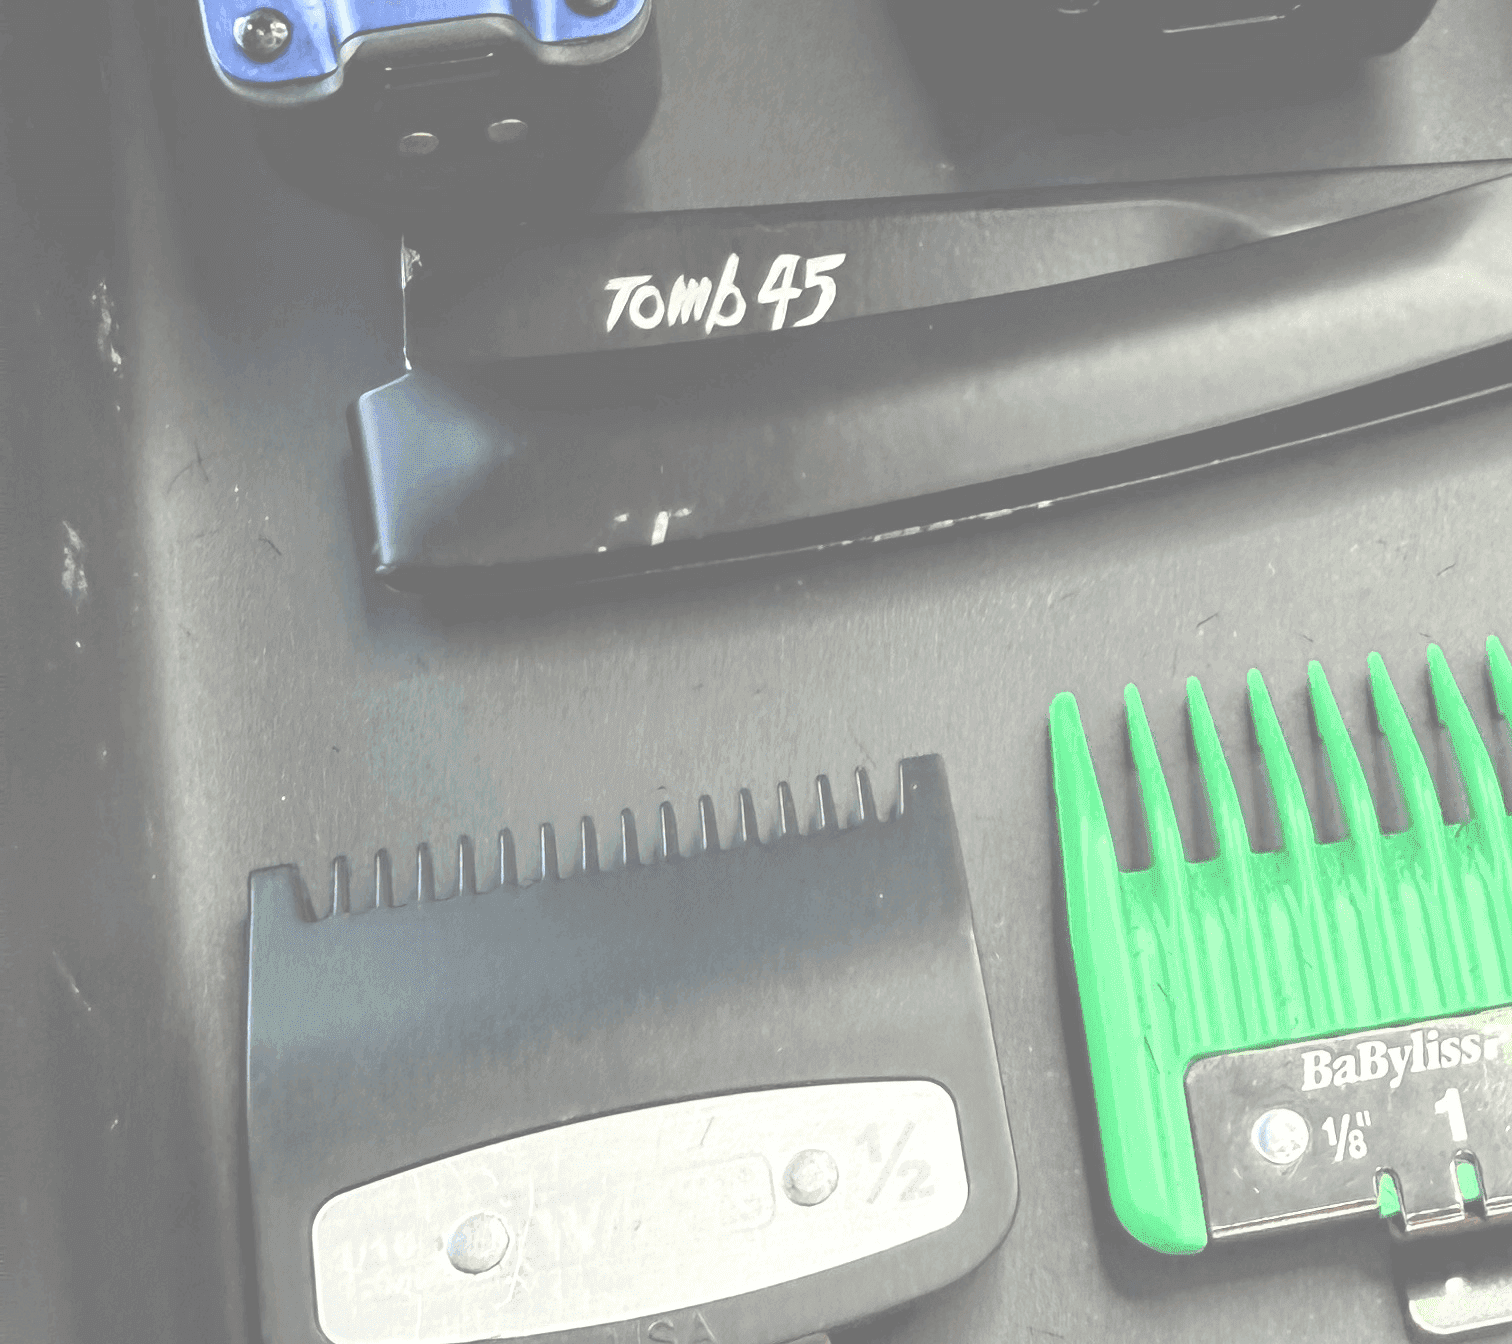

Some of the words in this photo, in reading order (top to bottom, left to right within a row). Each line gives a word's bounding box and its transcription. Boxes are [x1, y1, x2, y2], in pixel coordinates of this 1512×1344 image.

[757, 252, 847, 332] 45
[1434, 1087, 1469, 1142] 1
[854, 1119, 937, 1207] 1/2
